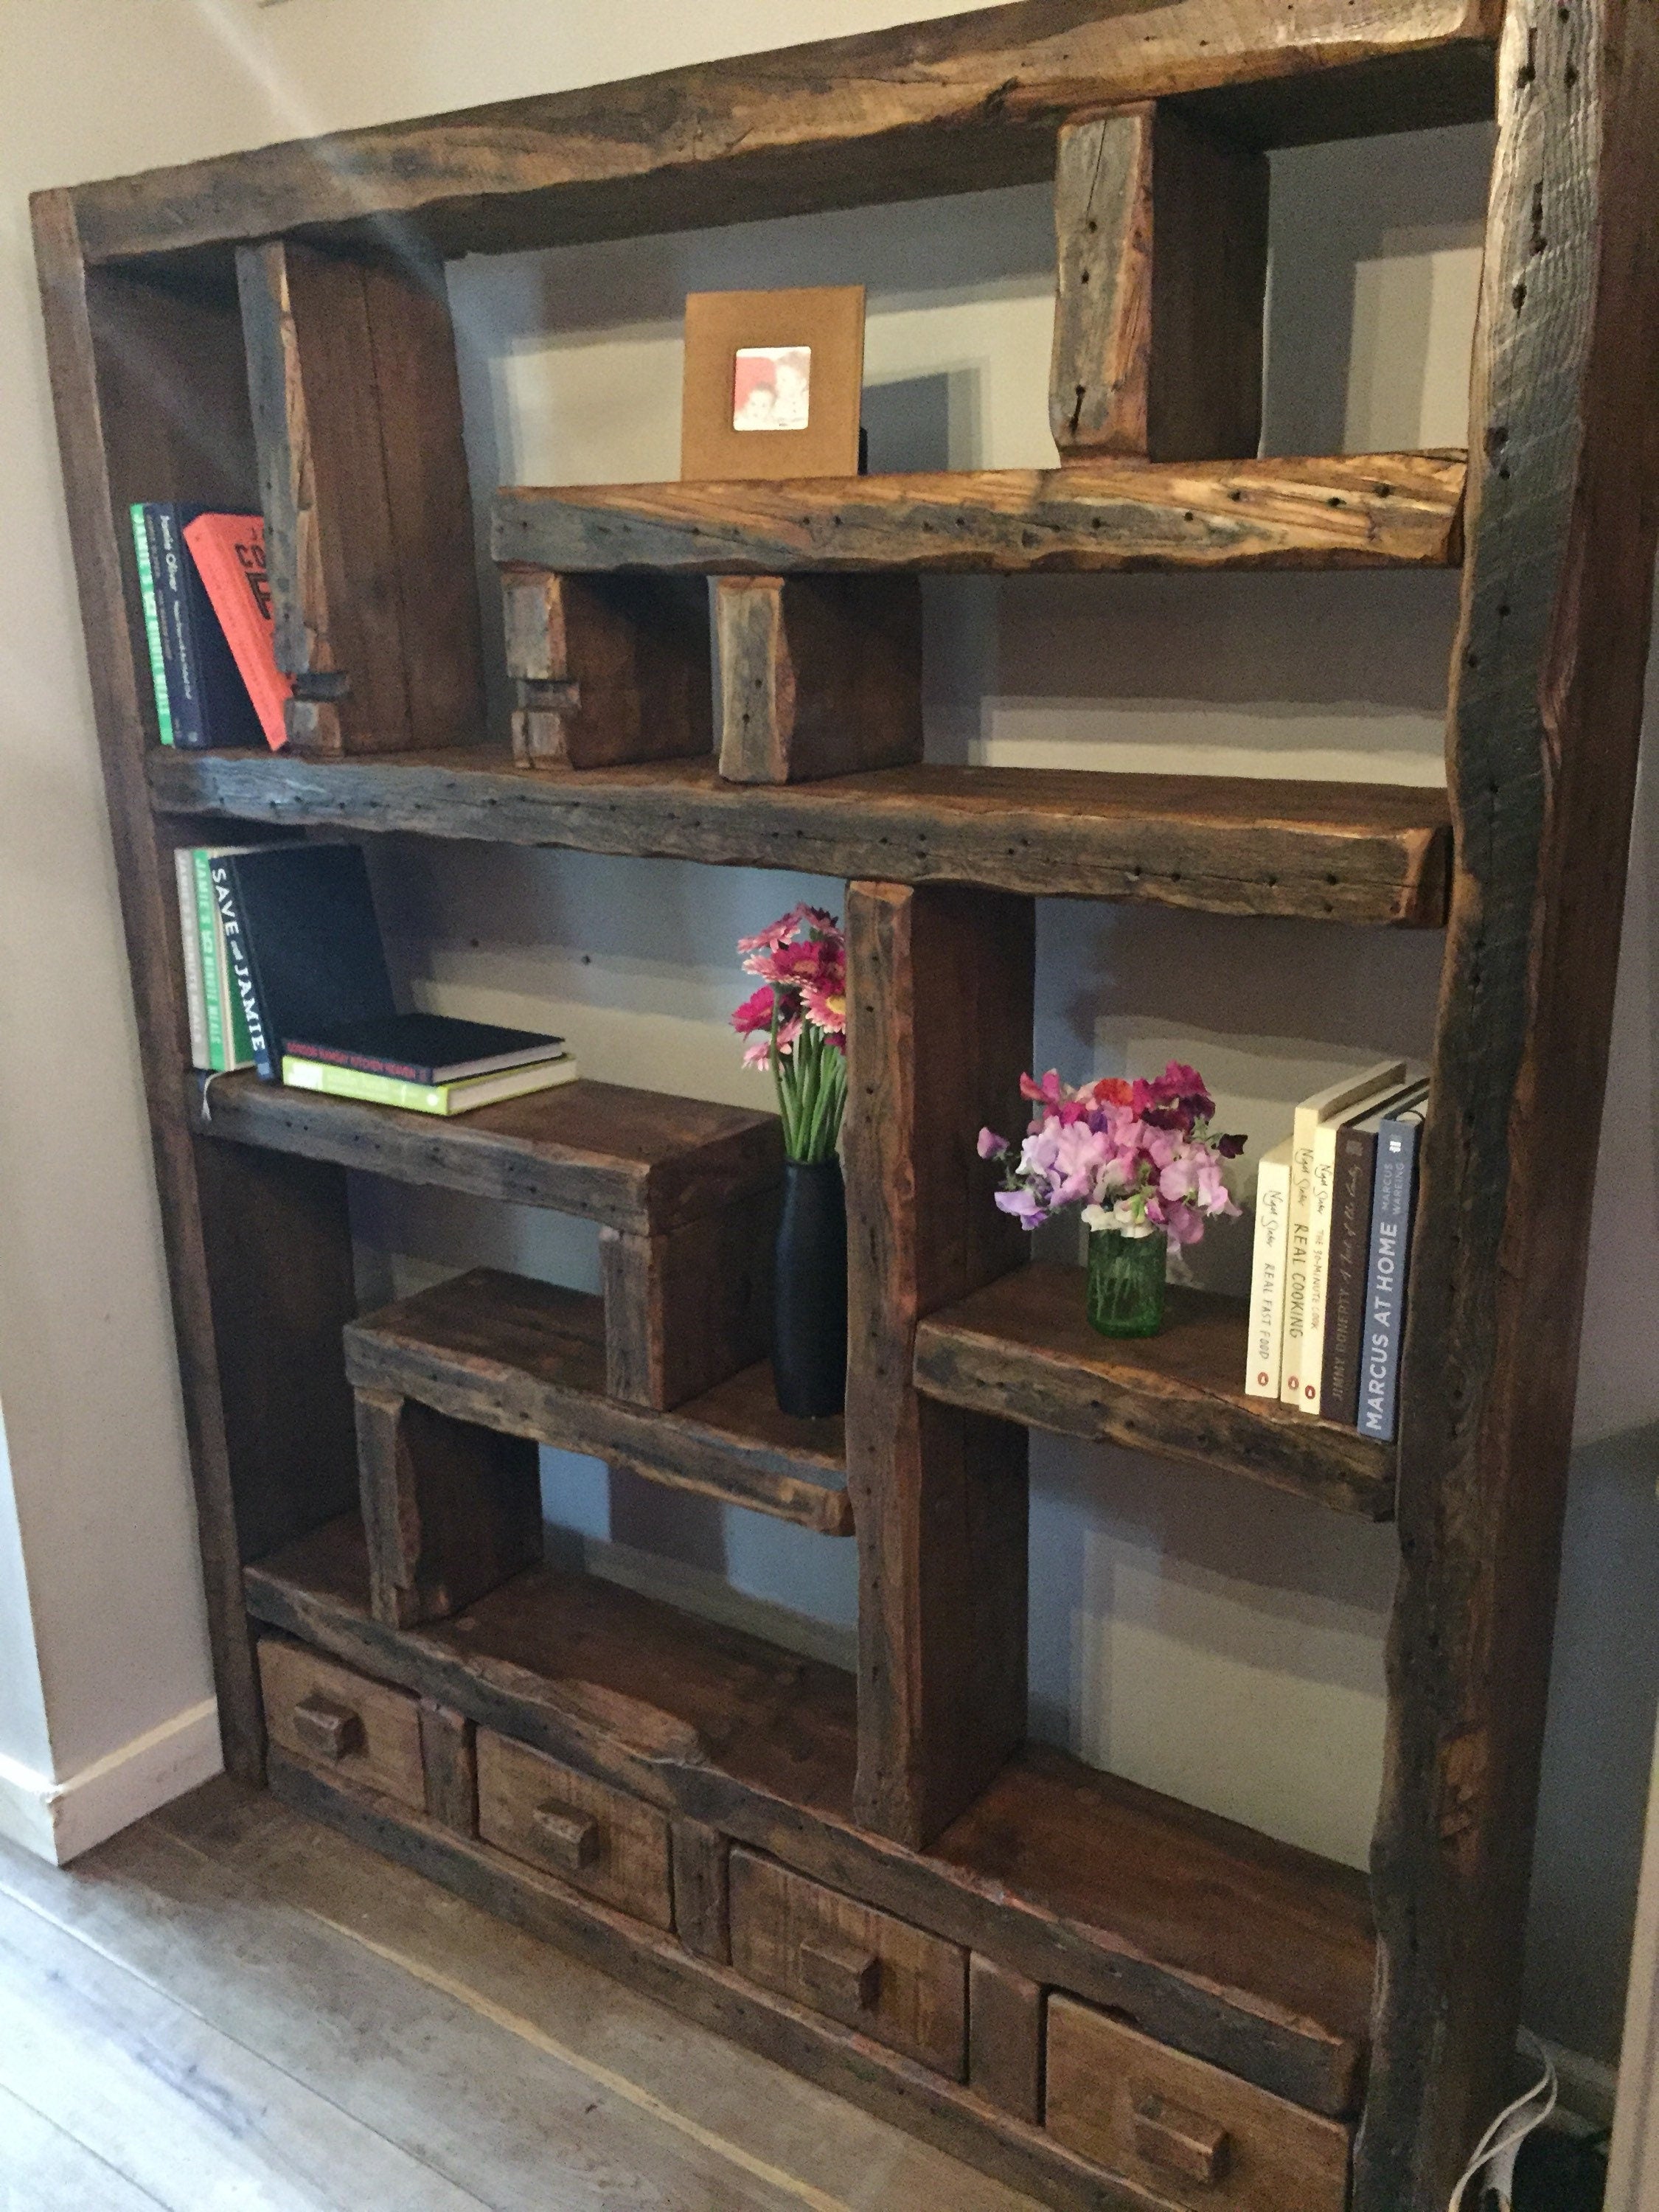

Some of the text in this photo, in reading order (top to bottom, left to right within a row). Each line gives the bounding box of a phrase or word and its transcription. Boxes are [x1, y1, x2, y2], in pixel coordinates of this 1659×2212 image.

[212, 869, 239, 936] SAVE
[234, 964, 265, 1051] JAMIE
[1381, 1163, 1394, 1210] MARCUS
[1392, 1163, 1405, 1215] WAREING
[1293, 1223, 1309, 1265] REAL
[1263, 1262, 1275, 1294] REAL
[1262, 1300, 1273, 1326] FAST
[1290, 1273, 1306, 1338] COOKING
[1366, 1222, 1397, 1430] MARCUS AT HOME
[1259, 1330, 1270, 1360] FOOD
